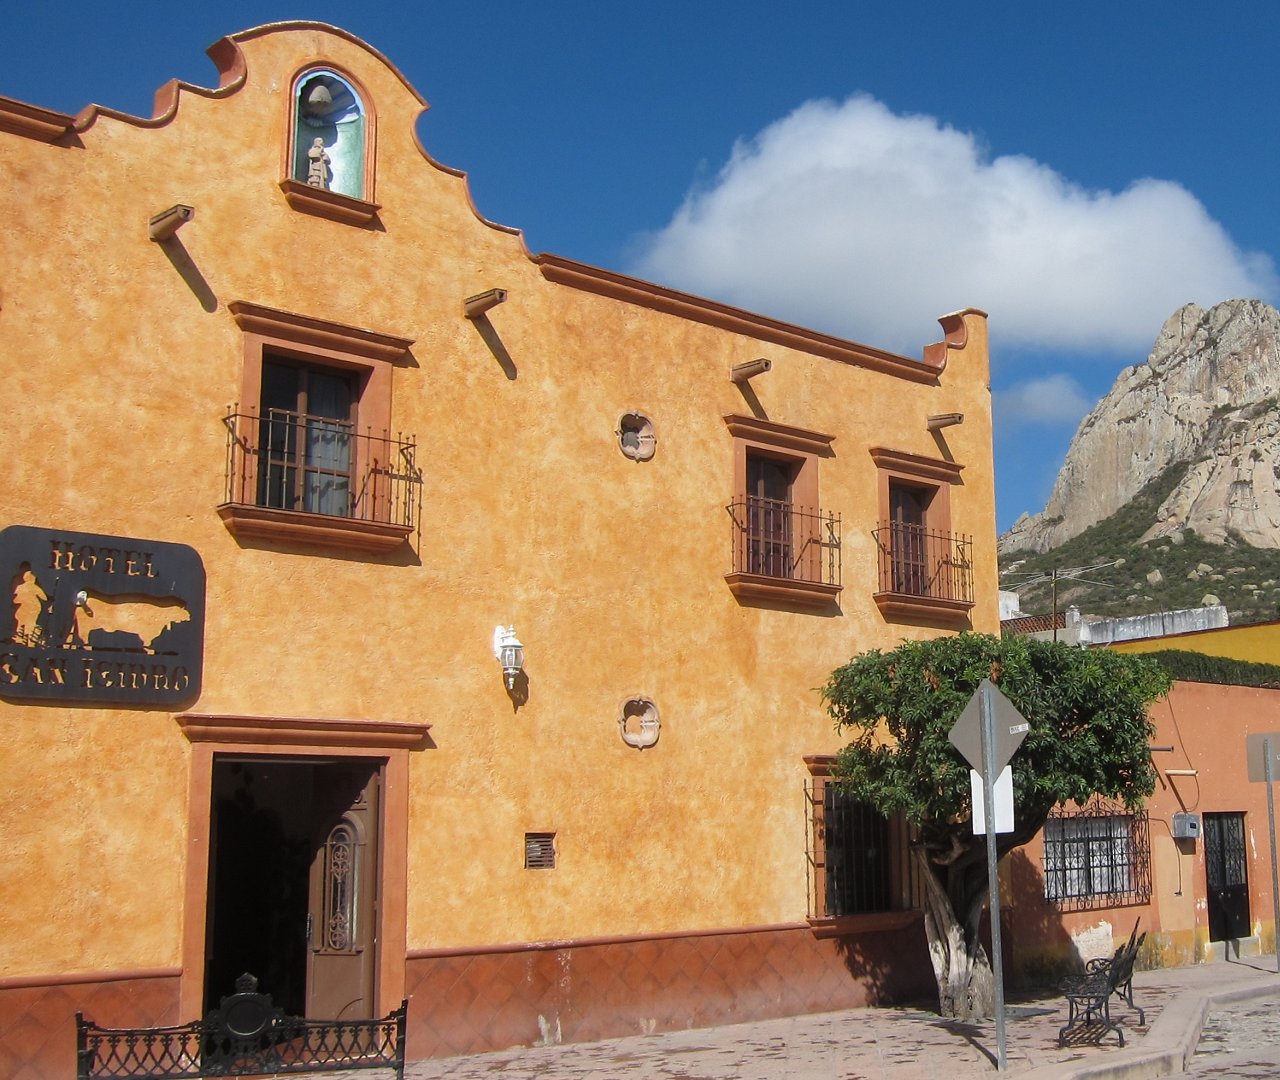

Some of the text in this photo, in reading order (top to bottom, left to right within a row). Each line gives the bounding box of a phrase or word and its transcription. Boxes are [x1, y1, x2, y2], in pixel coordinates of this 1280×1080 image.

[49, 540, 160, 578] HOTEL
[0, 652, 190, 691] SAN ISIDRO
